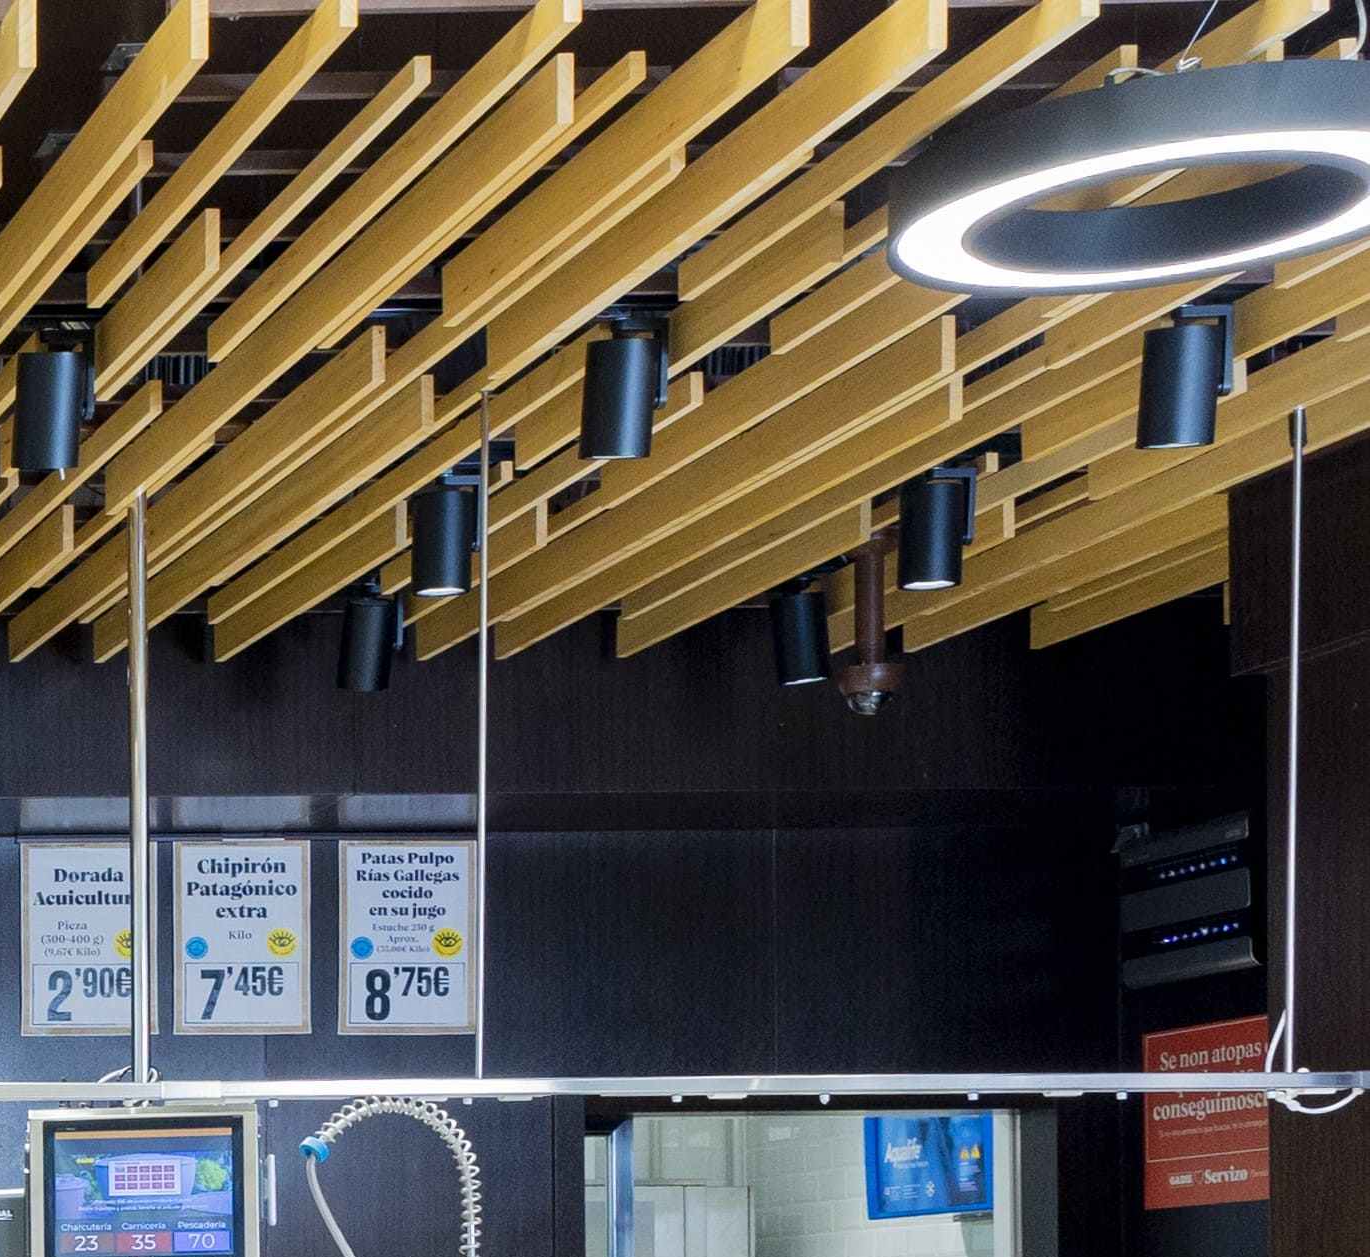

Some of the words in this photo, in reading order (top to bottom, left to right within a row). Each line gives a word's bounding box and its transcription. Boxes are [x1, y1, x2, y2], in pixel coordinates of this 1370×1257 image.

[197, 857, 286, 877] Chipirón
[361, 852, 404, 864] Patas
[409, 852, 454, 869] Pulpo
[54, 867, 124, 883] Dorada
[356, 869, 390, 882] Rías
[394, 869, 460, 885] Gallegas
[33, 890, 131, 905] Acuicultur
[187, 879, 297, 900] Patagónico
[382, 887, 433, 899] cocido
[215, 906, 268, 919] extra
[369, 906, 388, 917] en
[391, 906, 409, 917] su
[411, 903, 446, 919] jugo
[57, 921, 88, 931] Pieza
[228, 931, 252, 940] Kilo
[1160, 1052, 1177, 1071] Se
[1179, 1051, 1209, 1068] non
[1212, 1041, 1261, 1065] atopas
[1204, 1166, 1248, 1184] Servizo
[73, 1235, 99, 1251] 23
[130, 1234, 156, 1250] 35
[188, 1233, 215, 1249] 70
